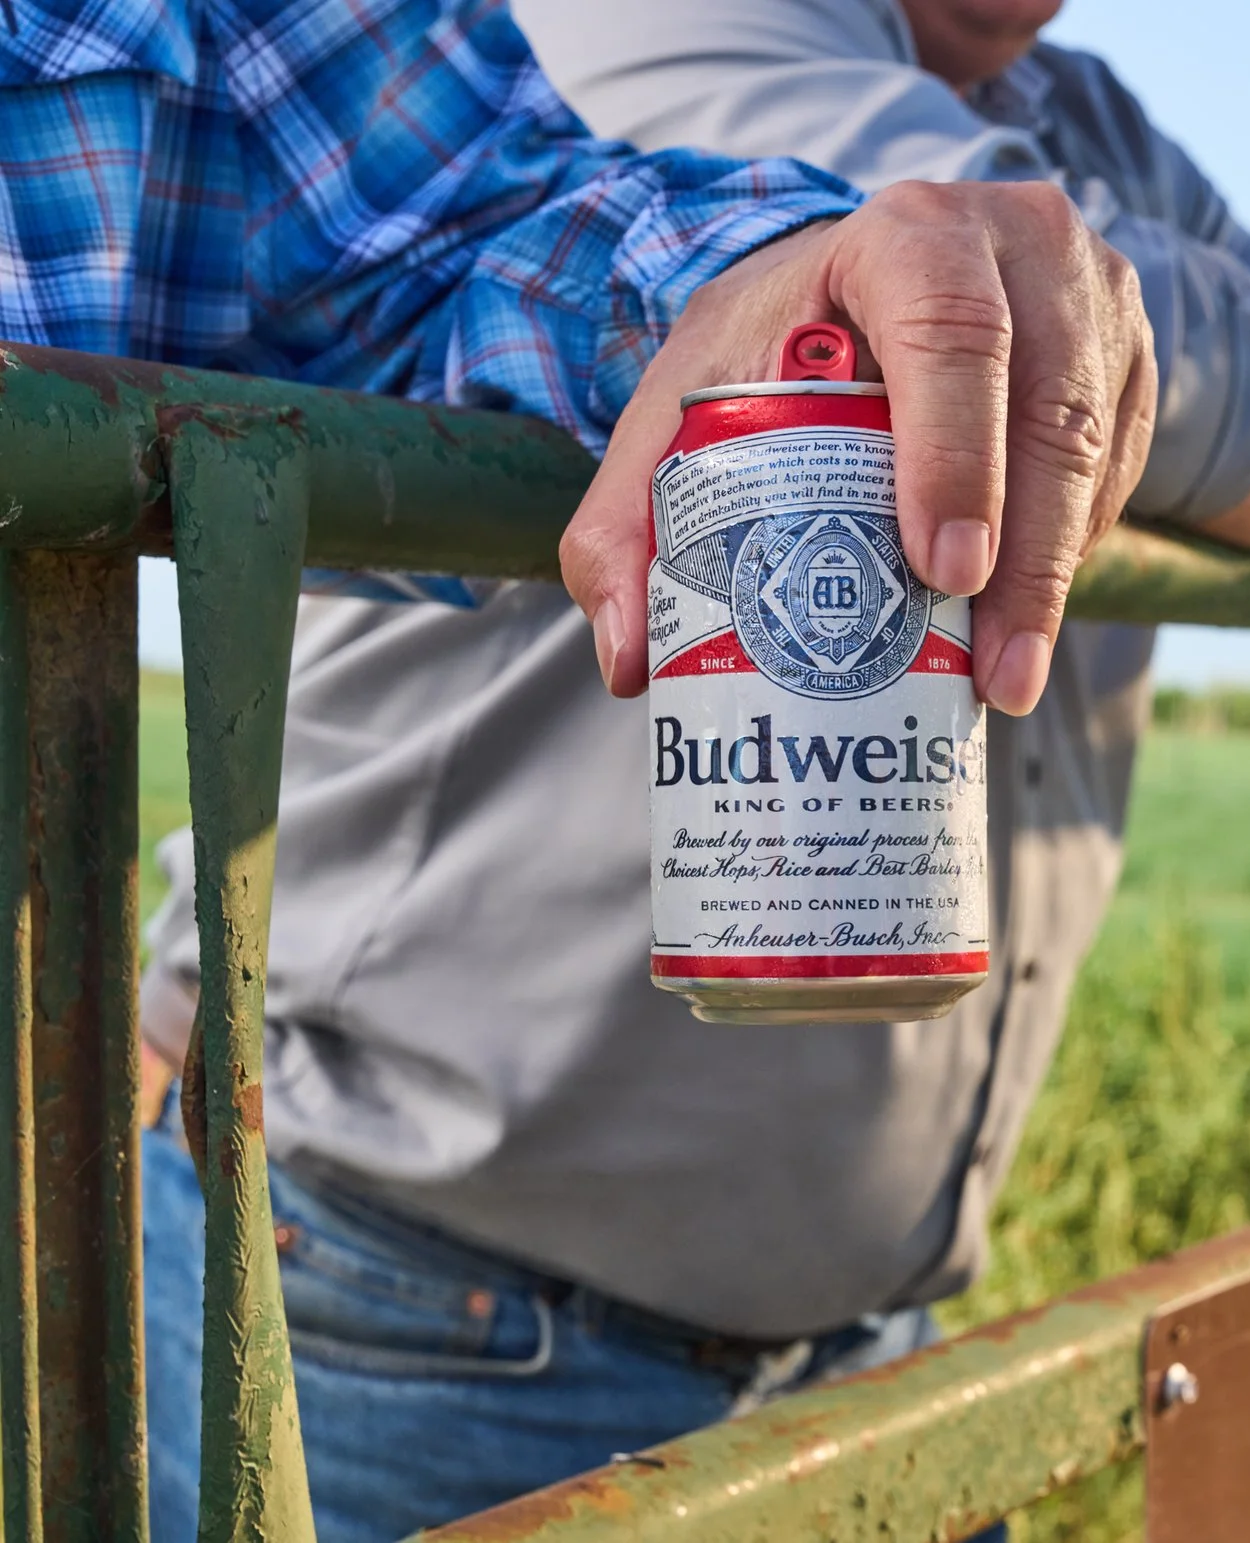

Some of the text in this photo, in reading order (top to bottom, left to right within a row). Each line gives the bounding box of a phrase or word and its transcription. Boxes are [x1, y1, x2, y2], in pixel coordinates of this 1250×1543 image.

[666, 480, 681, 496] This
[682, 474, 689, 484] is
[690, 466, 704, 479] the
[748, 442, 811, 458] Budweiser
[814, 442, 842, 452] beer.
[845, 442, 861, 452] We
[864, 444, 895, 456] know
[670, 456, 894, 511] by any other brewer which costs so much
[673, 496, 709, 525] exclusive
[713, 474, 777, 501] Beechwood
[826, 471, 884, 485] produces
[888, 478, 895, 487] a
[675, 524, 689, 540] and
[691, 520, 697, 528] a
[698, 496, 760, 524] drinkability
[764, 493, 787, 504] you
[792, 486, 813, 499] will
[817, 486, 843, 499] find
[847, 487, 859, 498] in
[863, 491, 878, 501] no
[766, 533, 900, 645] UNITED STATES OF
[812, 575, 858, 610] AB
[653, 596, 677, 616] GREAT
[771, 624, 793, 647] THE
[700, 657, 736, 670] SINCE
[928, 658, 950, 669] 1876
[811, 674, 859, 689] AMERICA
[714, 799, 785, 813] KING
[802, 798, 843, 812] OF
[673, 828, 726, 849] Brewed
[729, 829, 751, 857] by
[756, 834, 789, 847] our
[793, 828, 870, 857] original
[870, 833, 929, 853] process
[661, 857, 709, 879] Choicest
[709, 856, 761, 884] Hops,
[752, 855, 813, 877] Rice
[814, 858, 860, 876] and
[858, 853, 910, 876] Best
[909, 853, 960, 884] Barley
[701, 897, 960, 911] BREWED AND CANNED IN THE USA
[907, 920, 958, 946] Inc.
